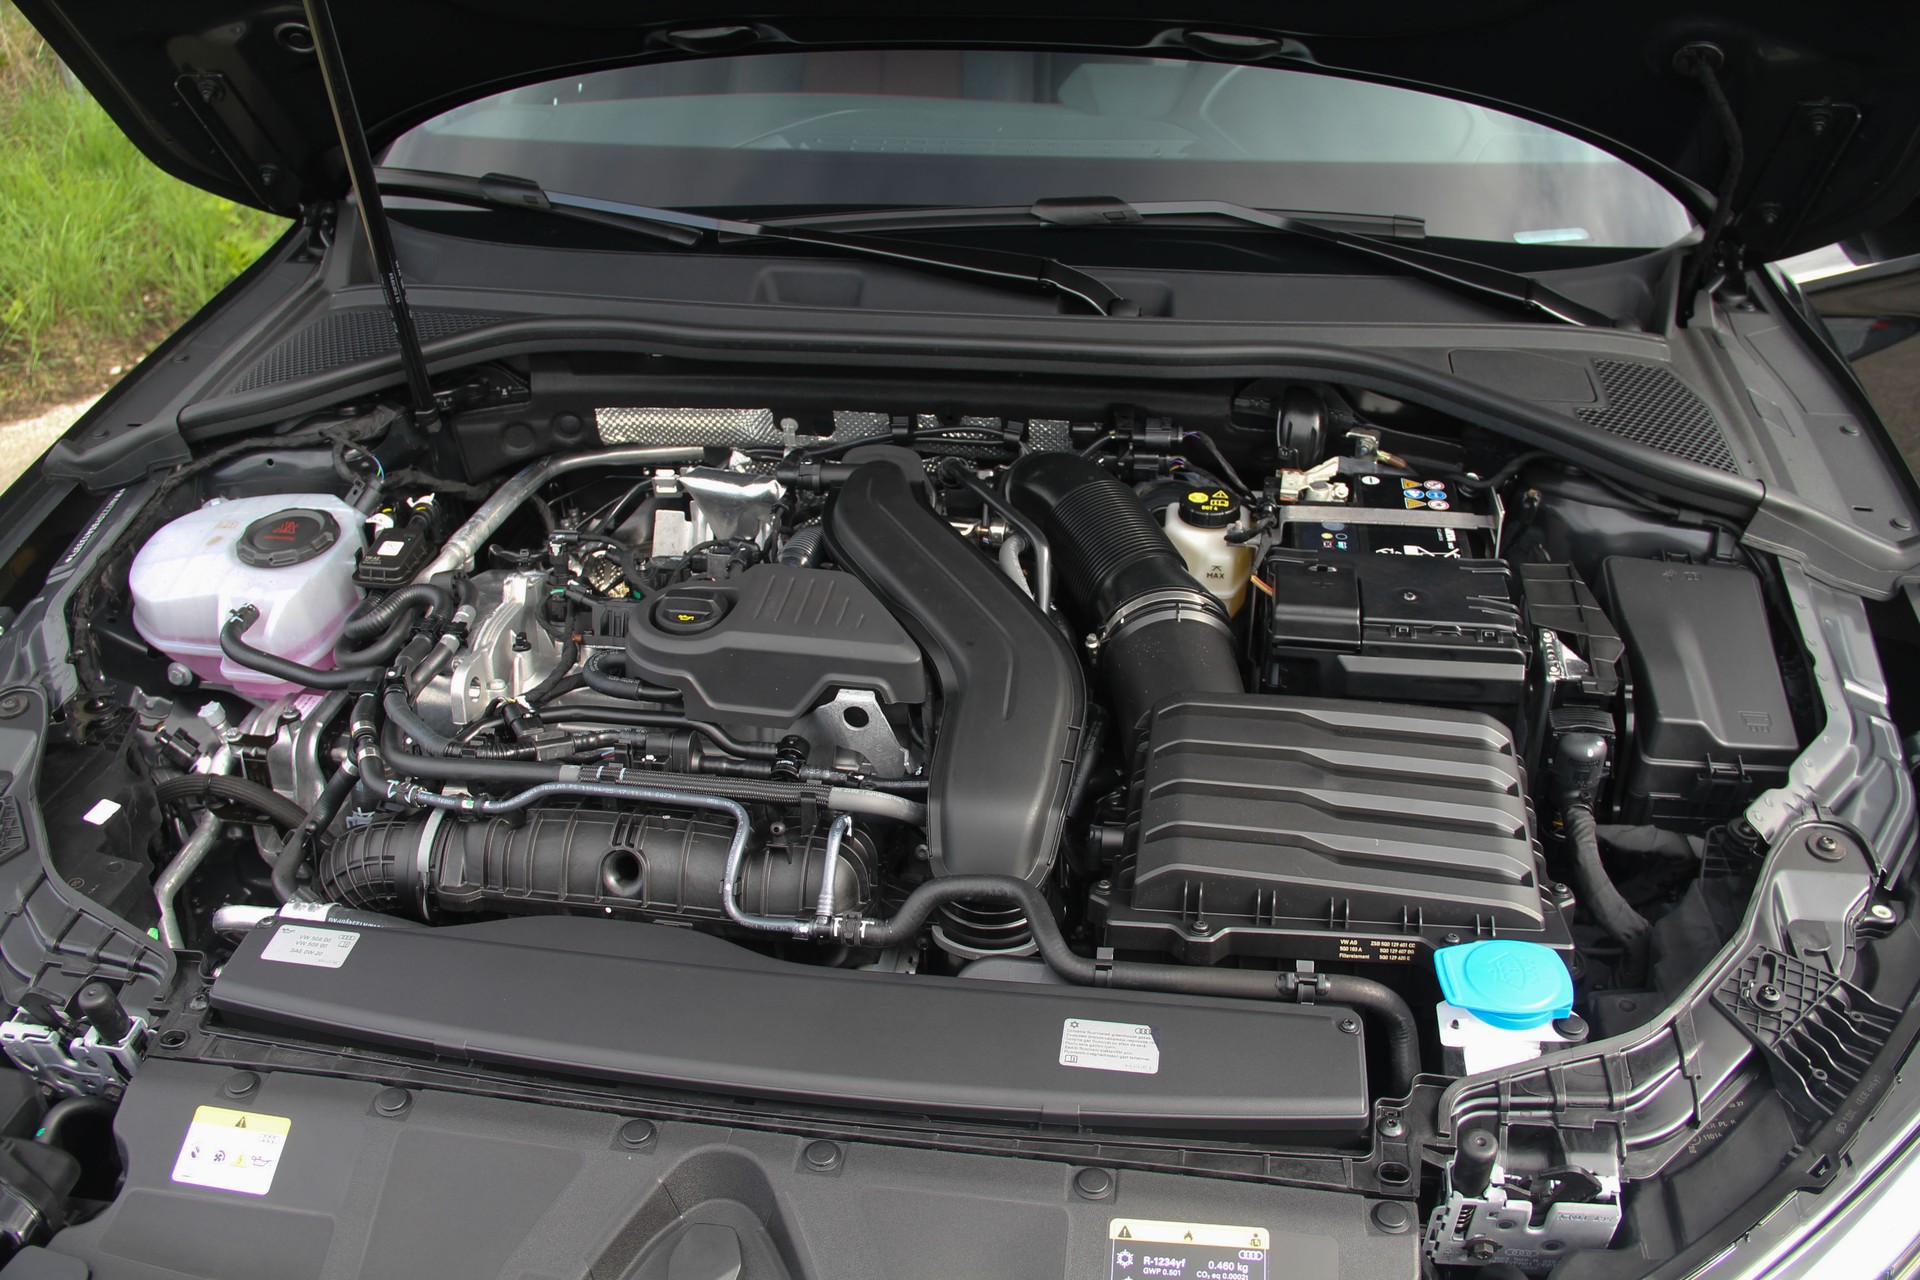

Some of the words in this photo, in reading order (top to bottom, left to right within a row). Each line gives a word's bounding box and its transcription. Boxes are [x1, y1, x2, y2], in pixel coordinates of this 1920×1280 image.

[1143, 1255, 1187, 1269] R-1234yf
[1207, 1260, 1235, 1272] 0.460
[1236, 1261, 1250, 1274] kg
[1142, 1267, 1162, 1275] GWP
[1162, 1268, 1181, 1276] 0.501
[1211, 1272, 1221, 1280] eq
